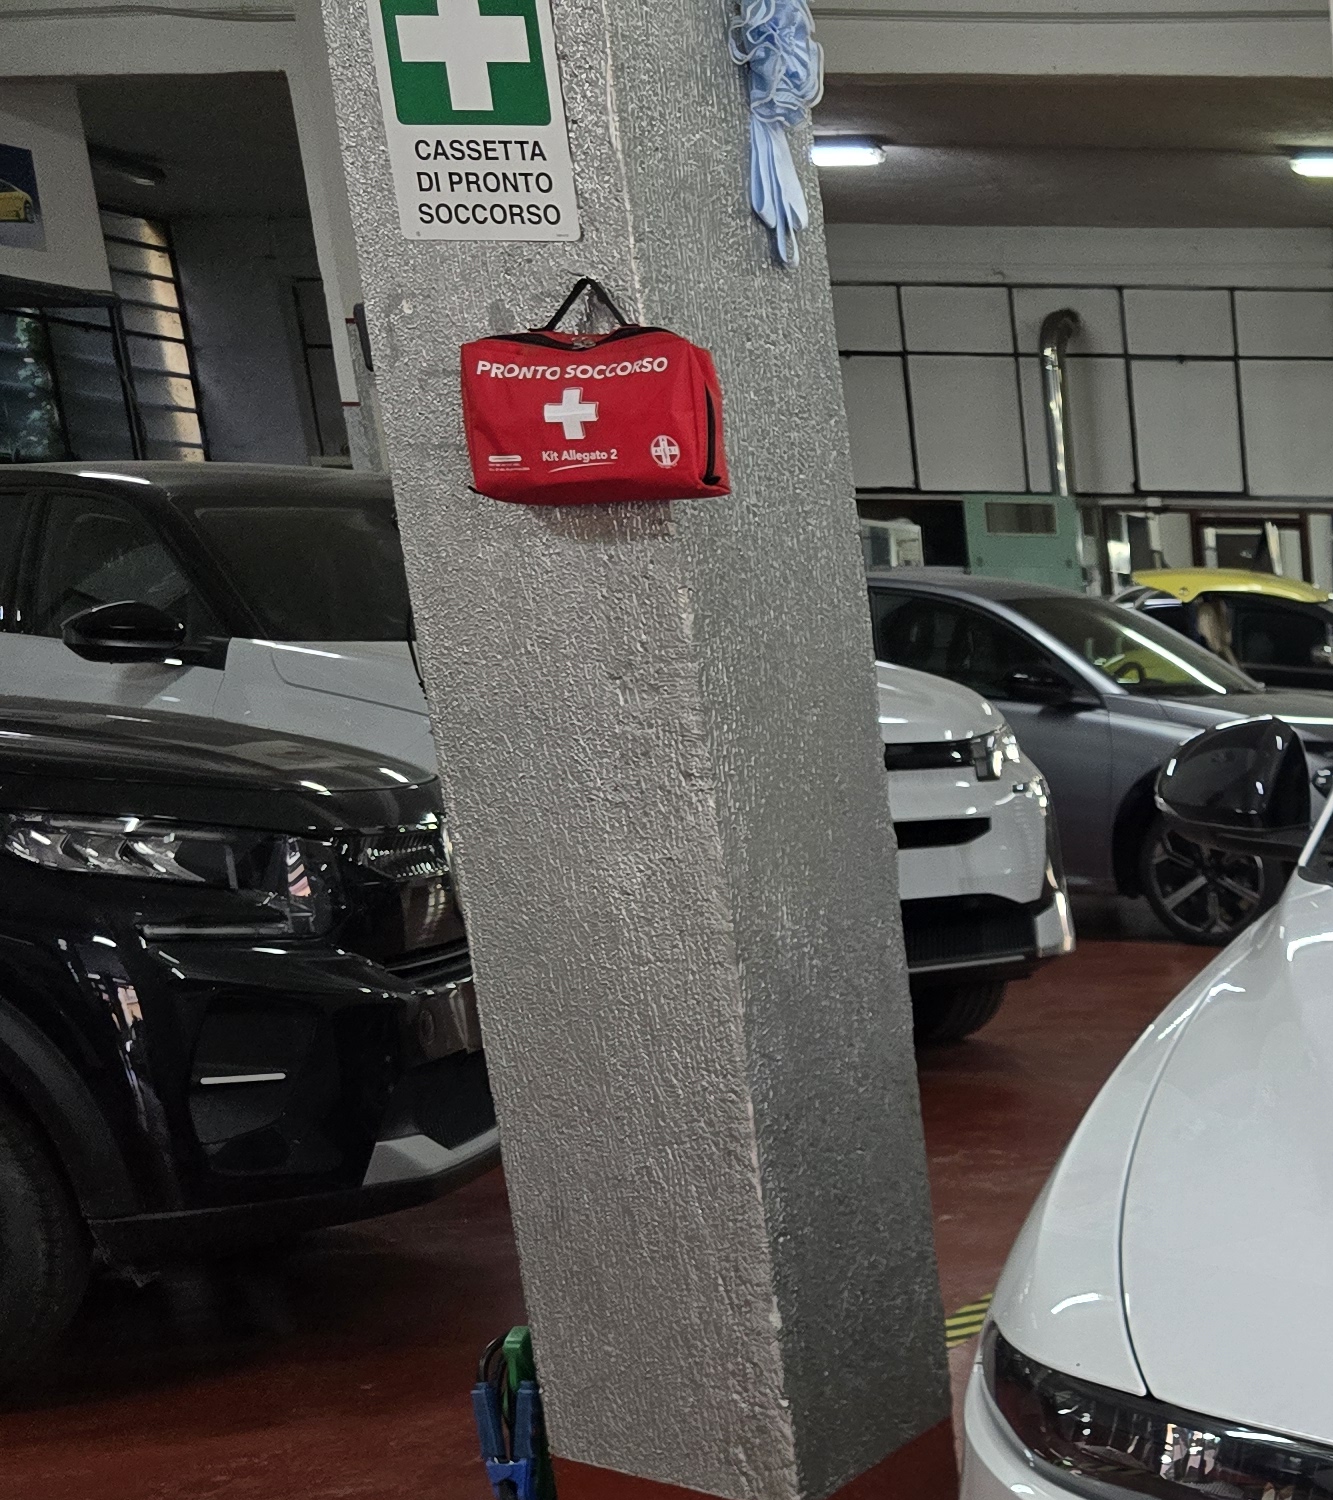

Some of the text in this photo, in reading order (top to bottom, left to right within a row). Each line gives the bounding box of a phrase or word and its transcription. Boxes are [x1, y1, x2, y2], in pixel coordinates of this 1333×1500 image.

[414, 139, 548, 163] CASSETTA
[416, 170, 554, 194] DI PRONTO
[418, 203, 562, 226] SOCCORSO
[476, 356, 669, 381] PRONTO SOCCORSO
[541, 448, 619, 463] Kit Allegato 2
